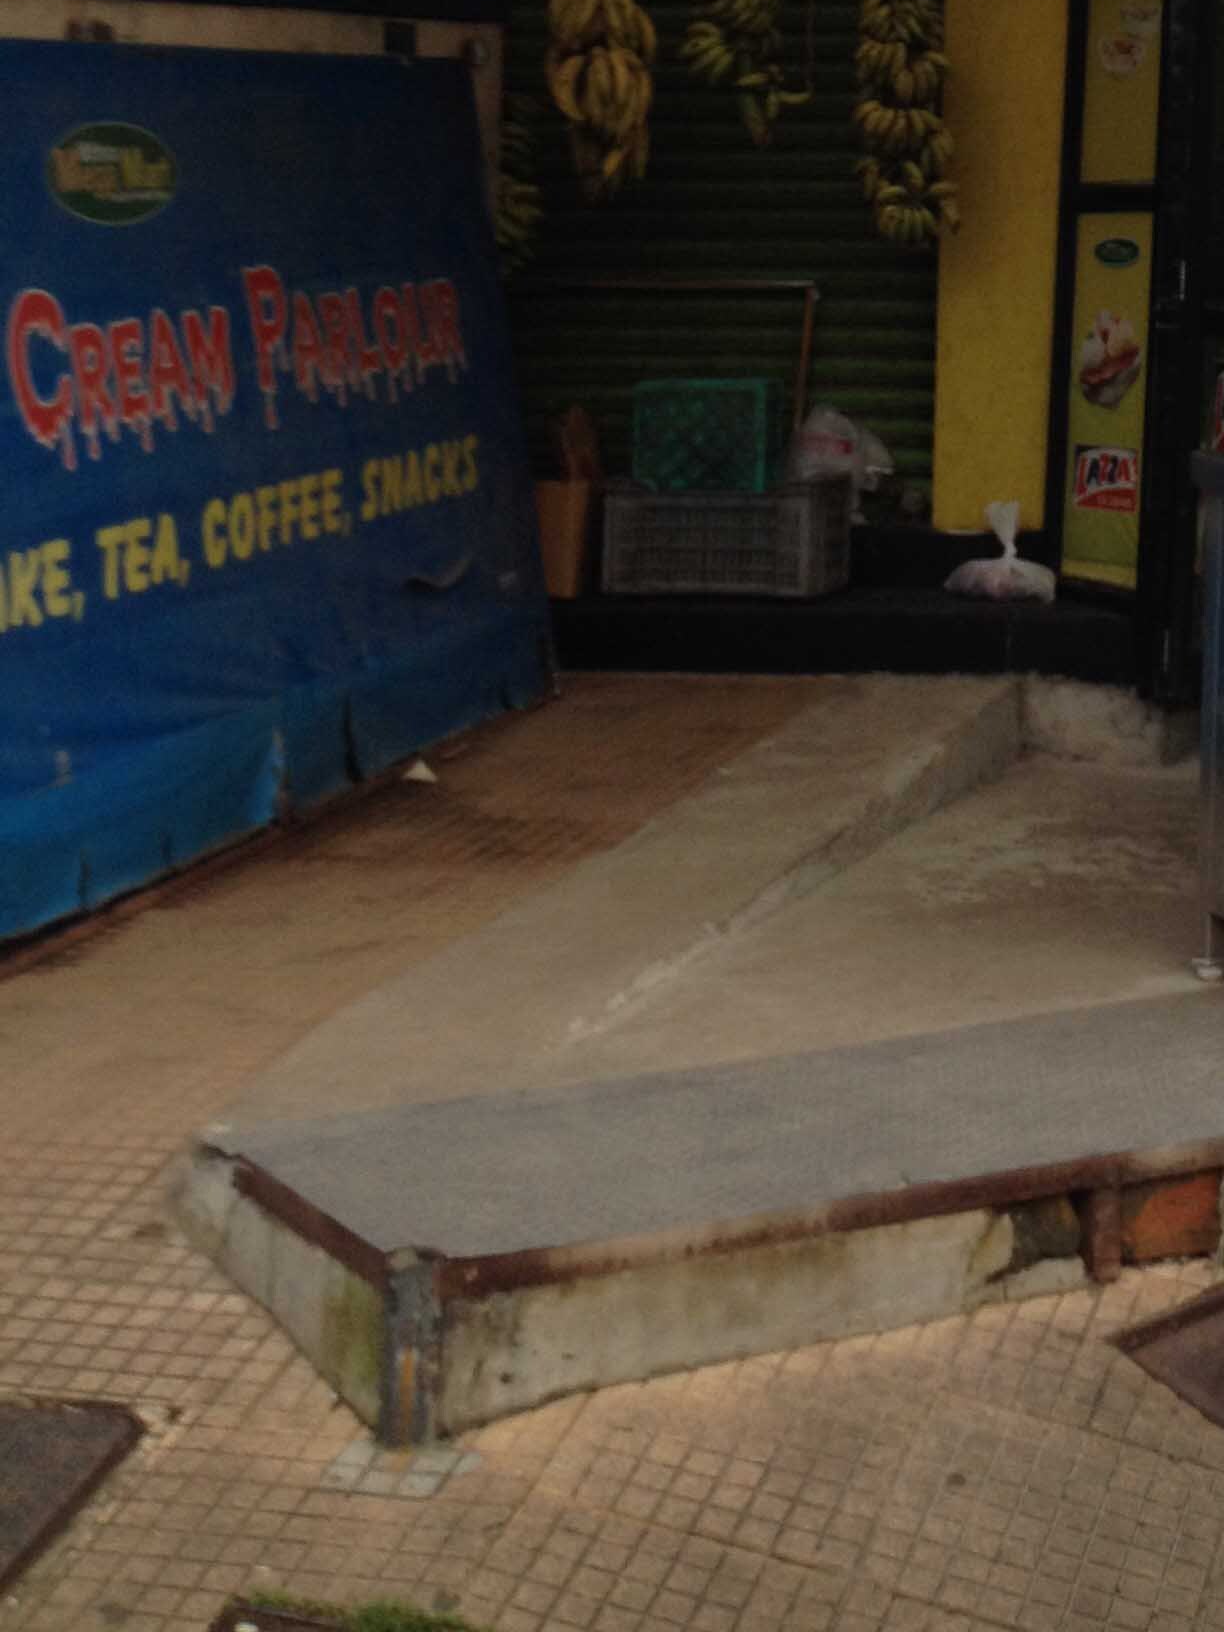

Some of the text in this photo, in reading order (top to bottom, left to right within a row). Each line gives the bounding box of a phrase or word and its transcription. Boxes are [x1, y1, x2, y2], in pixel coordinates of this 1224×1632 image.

[6, 264, 468, 472] CREAM PARLOUR
[361, 433, 479, 521] SNACKS
